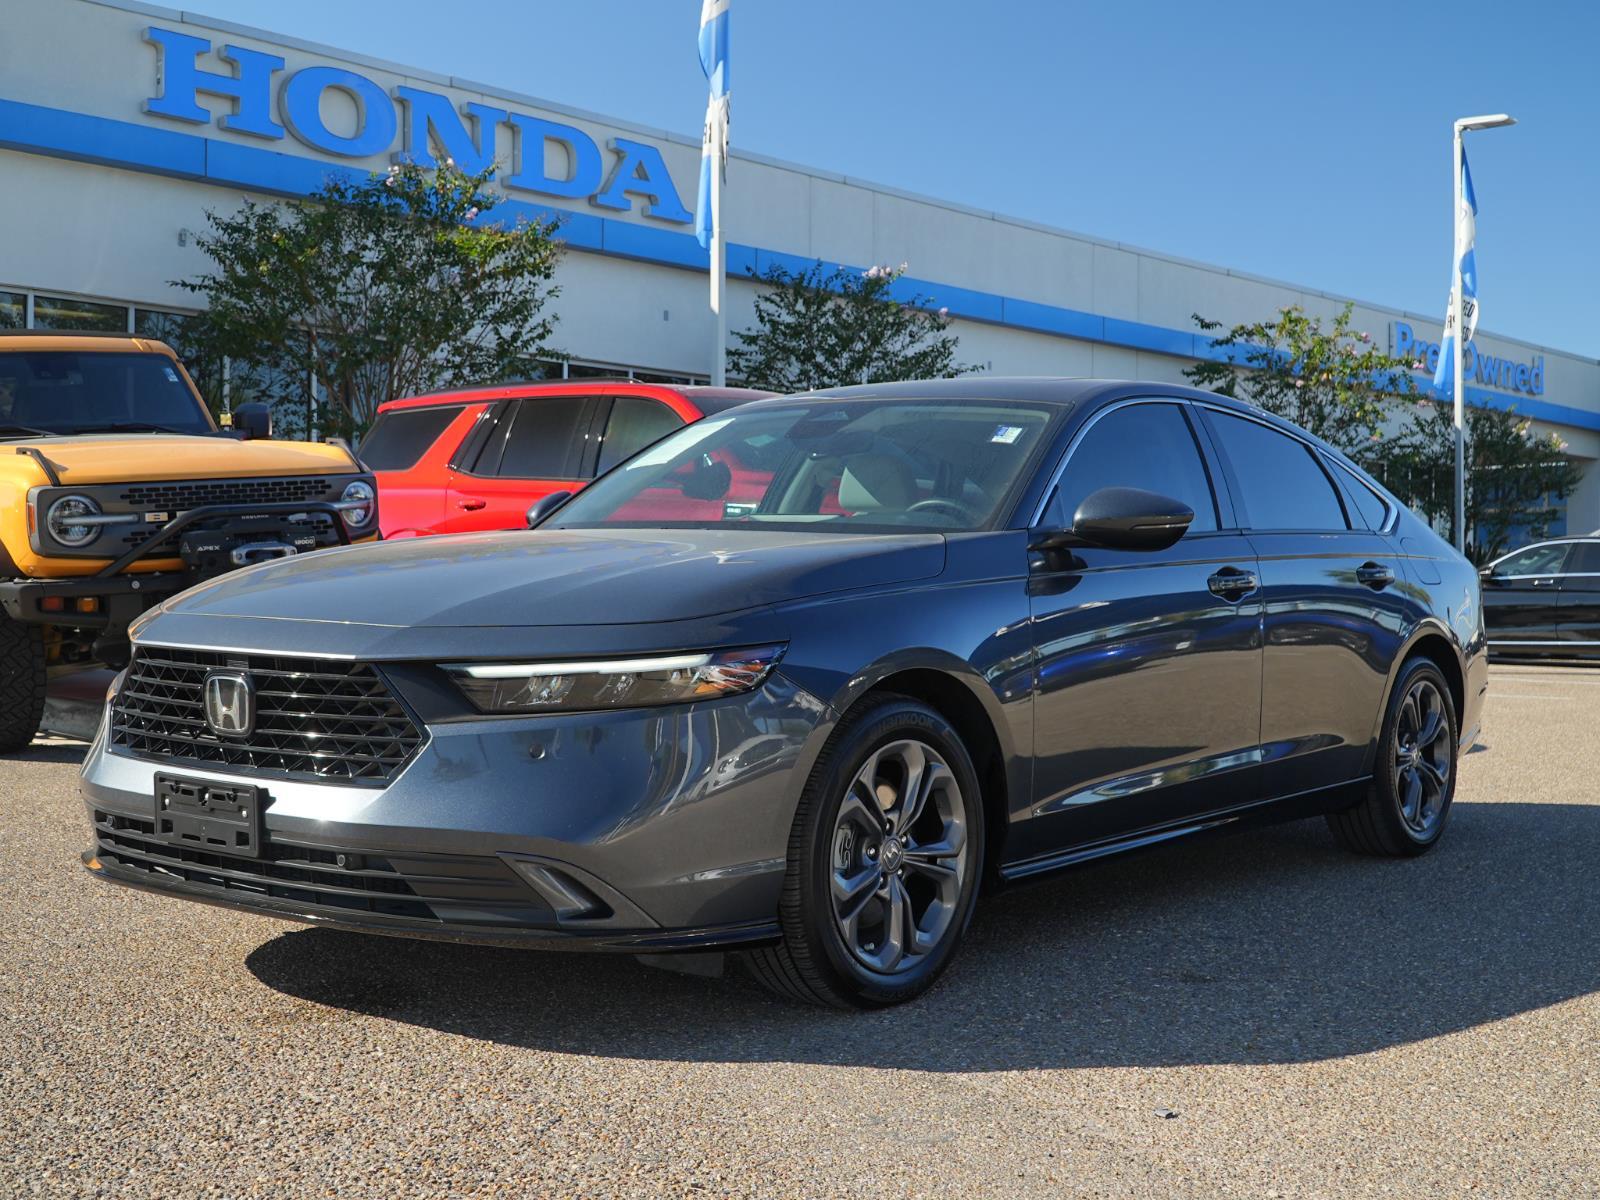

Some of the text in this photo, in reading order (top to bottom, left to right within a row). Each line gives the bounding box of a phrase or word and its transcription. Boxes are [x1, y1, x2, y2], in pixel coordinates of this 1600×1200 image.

[143, 26, 693, 224] HONDA
[1393, 321, 1544, 395] PreOwned
[197, 543, 220, 552] APEX
